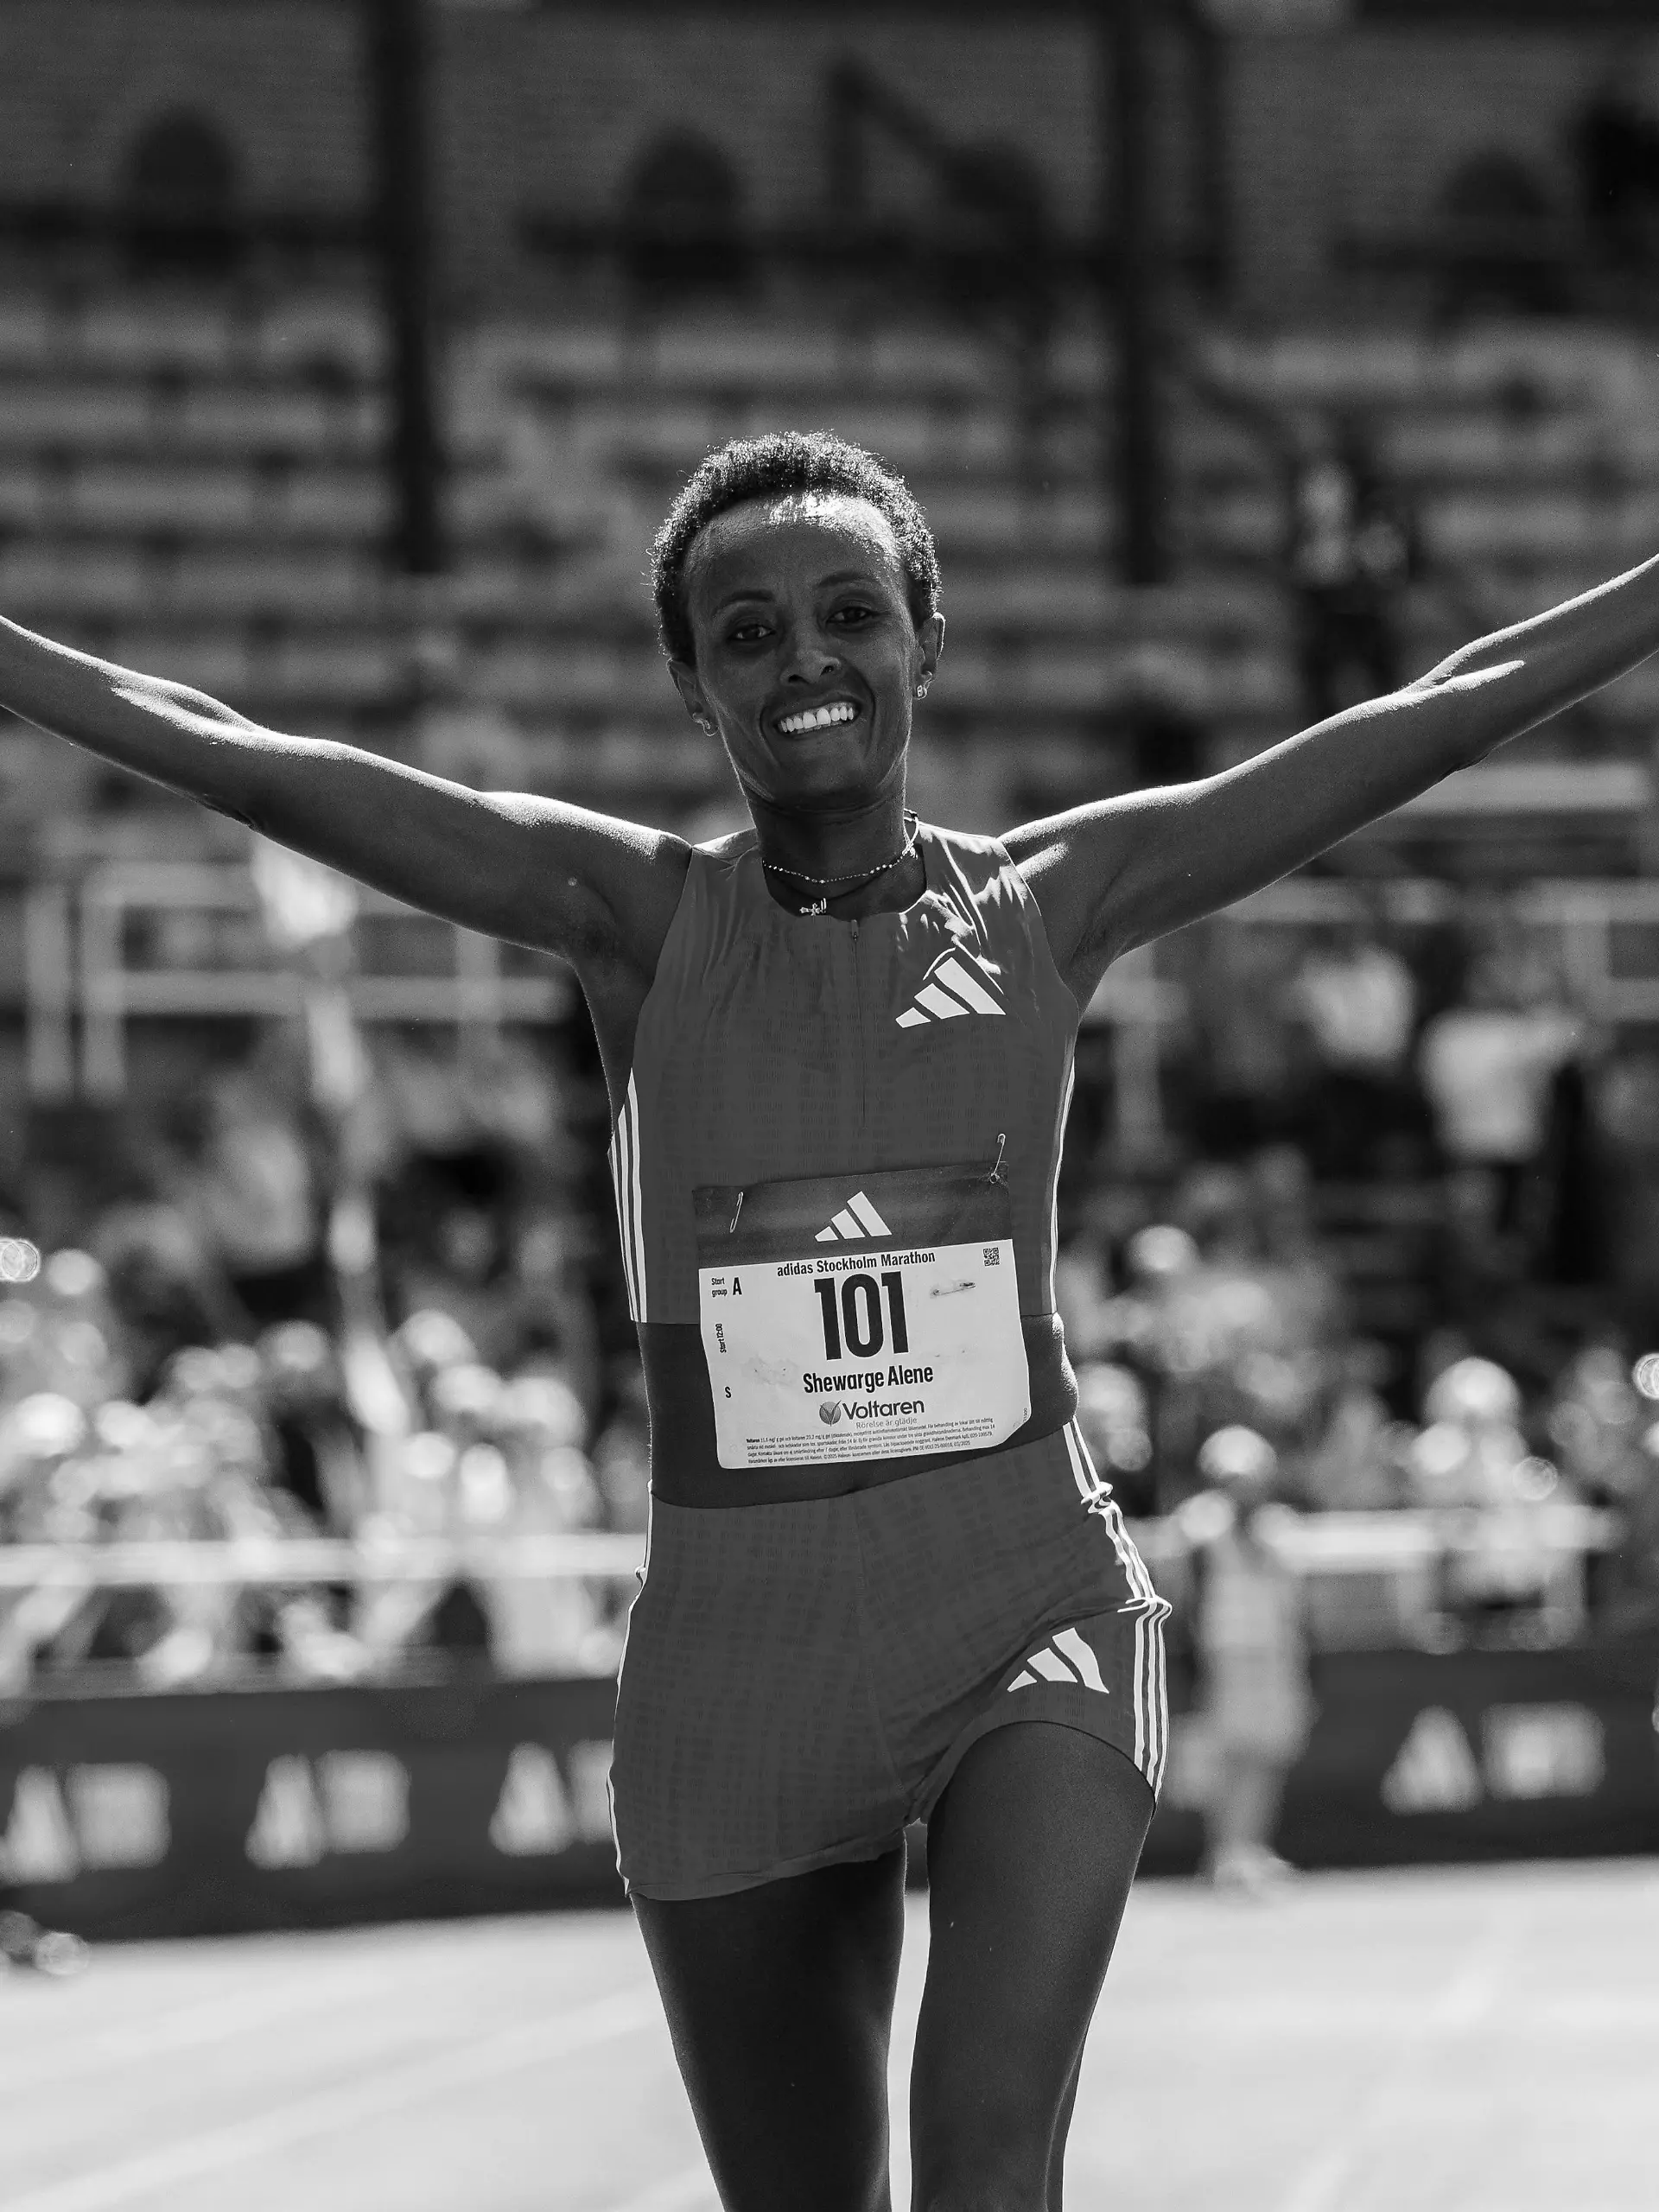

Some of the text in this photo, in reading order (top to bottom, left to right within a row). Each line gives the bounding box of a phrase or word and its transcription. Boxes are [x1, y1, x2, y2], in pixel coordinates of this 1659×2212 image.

[777, 1251, 936, 1276] adidas Stockholm Marathon
[711, 1277, 725, 1286] Start
[732, 1276, 742, 1296] A
[711, 1288, 728, 1298] group
[813, 1271, 909, 1361] 101
[803, 1364, 934, 1394] Shewarge Alene
[724, 1386, 732, 1399] S
[842, 1400, 925, 1420] Voltaren
[894, 1416, 918, 1427] glädje
